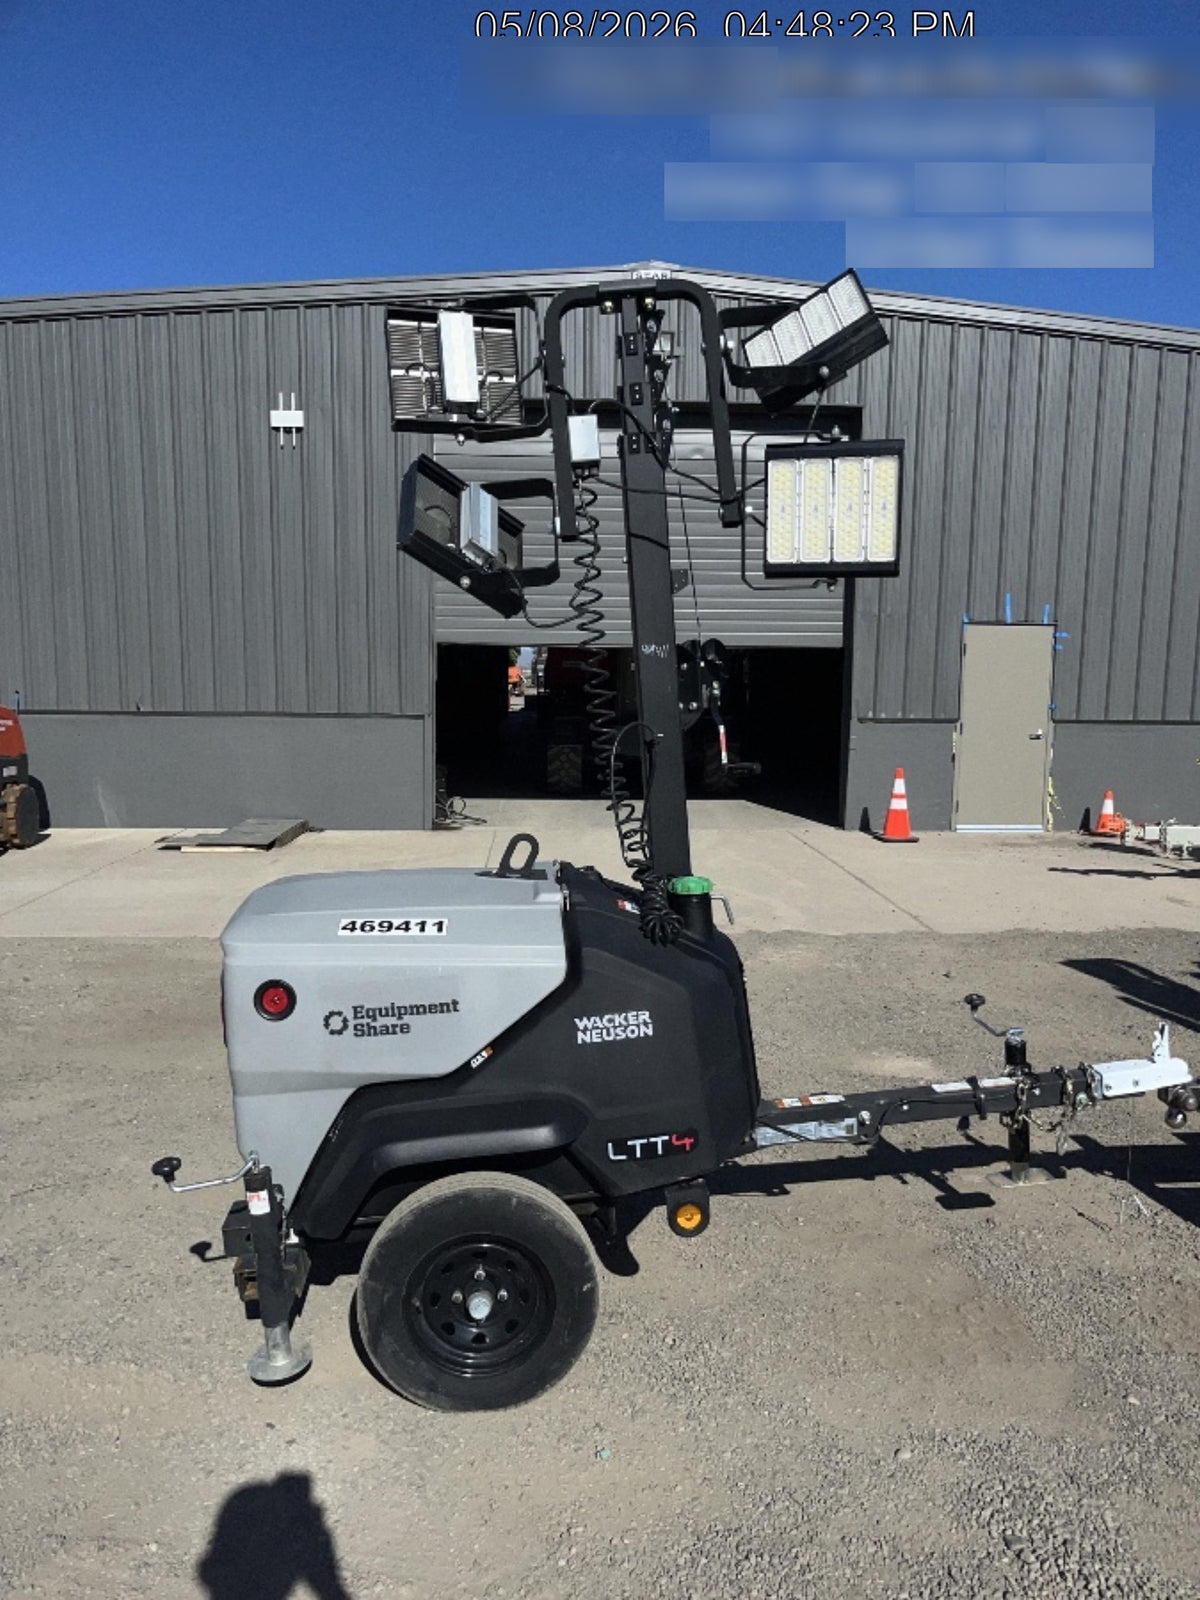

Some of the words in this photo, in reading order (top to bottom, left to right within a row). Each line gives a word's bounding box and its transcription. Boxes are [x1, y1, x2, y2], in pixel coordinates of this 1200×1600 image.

[341, 920, 445, 933] 469411
[352, 999, 460, 1022] Equipment
[574, 1010, 653, 1030] WACKER
[353, 1022, 411, 1038] Share
[577, 1024, 653, 1044] NEUSON
[607, 1134, 694, 1160] LTT4
